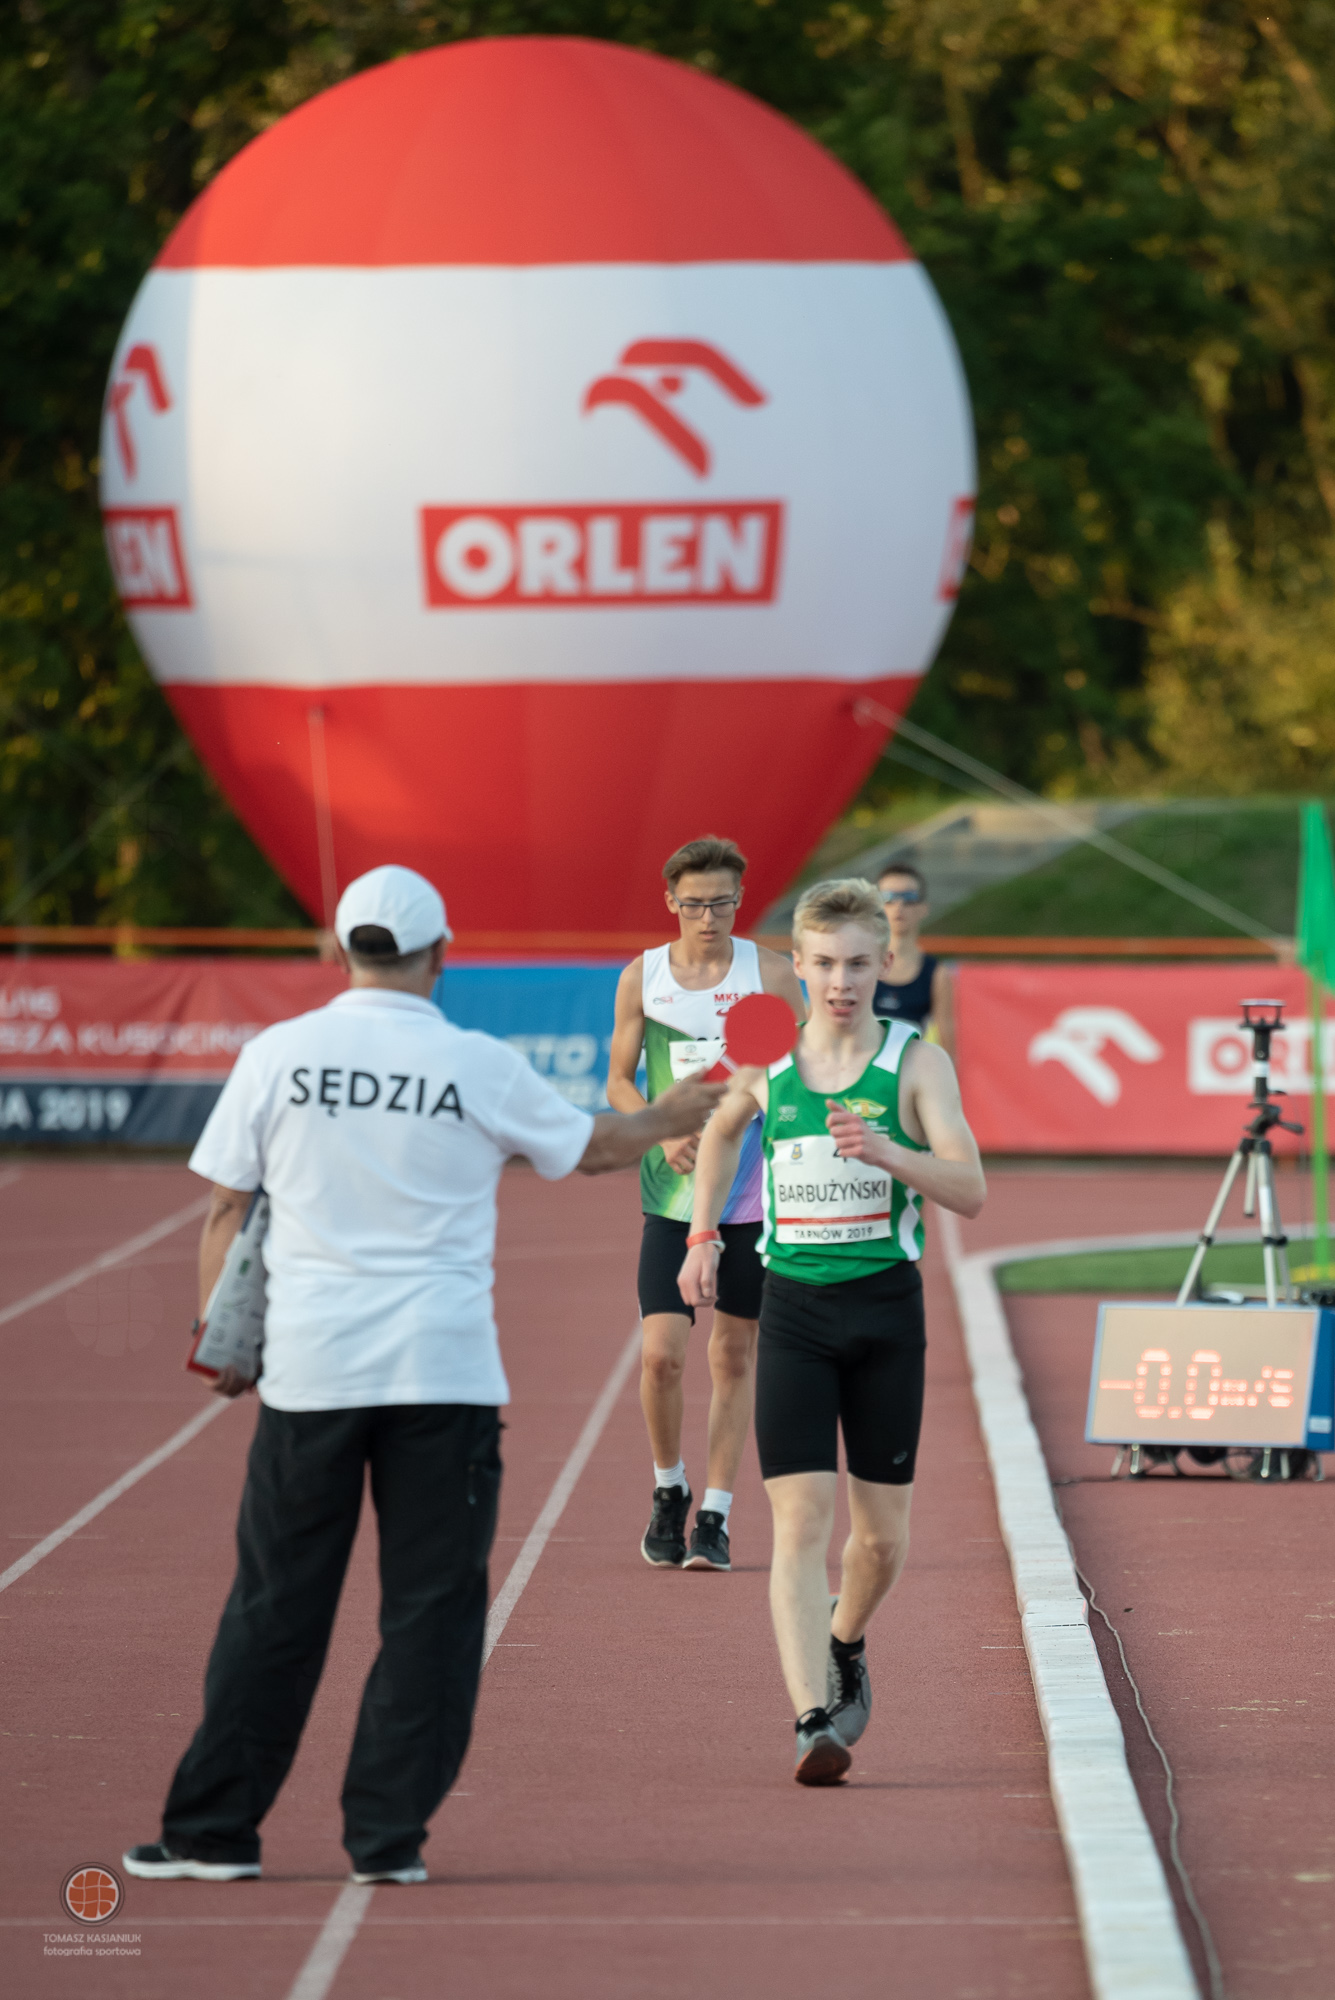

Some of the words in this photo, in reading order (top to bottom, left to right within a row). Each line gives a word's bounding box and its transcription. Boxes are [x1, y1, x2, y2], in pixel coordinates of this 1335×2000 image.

[434, 513, 768, 598] ORLEN
[714, 993, 739, 1003] MKS
[38, 1087, 131, 1131] 2019
[289, 1067, 464, 1121] SĘDZIA
[778, 1178, 887, 1203] BARBUŻYŃSKI
[794, 1228, 842, 1240] TARNÓW
[847, 1226, 874, 1239] 2019
